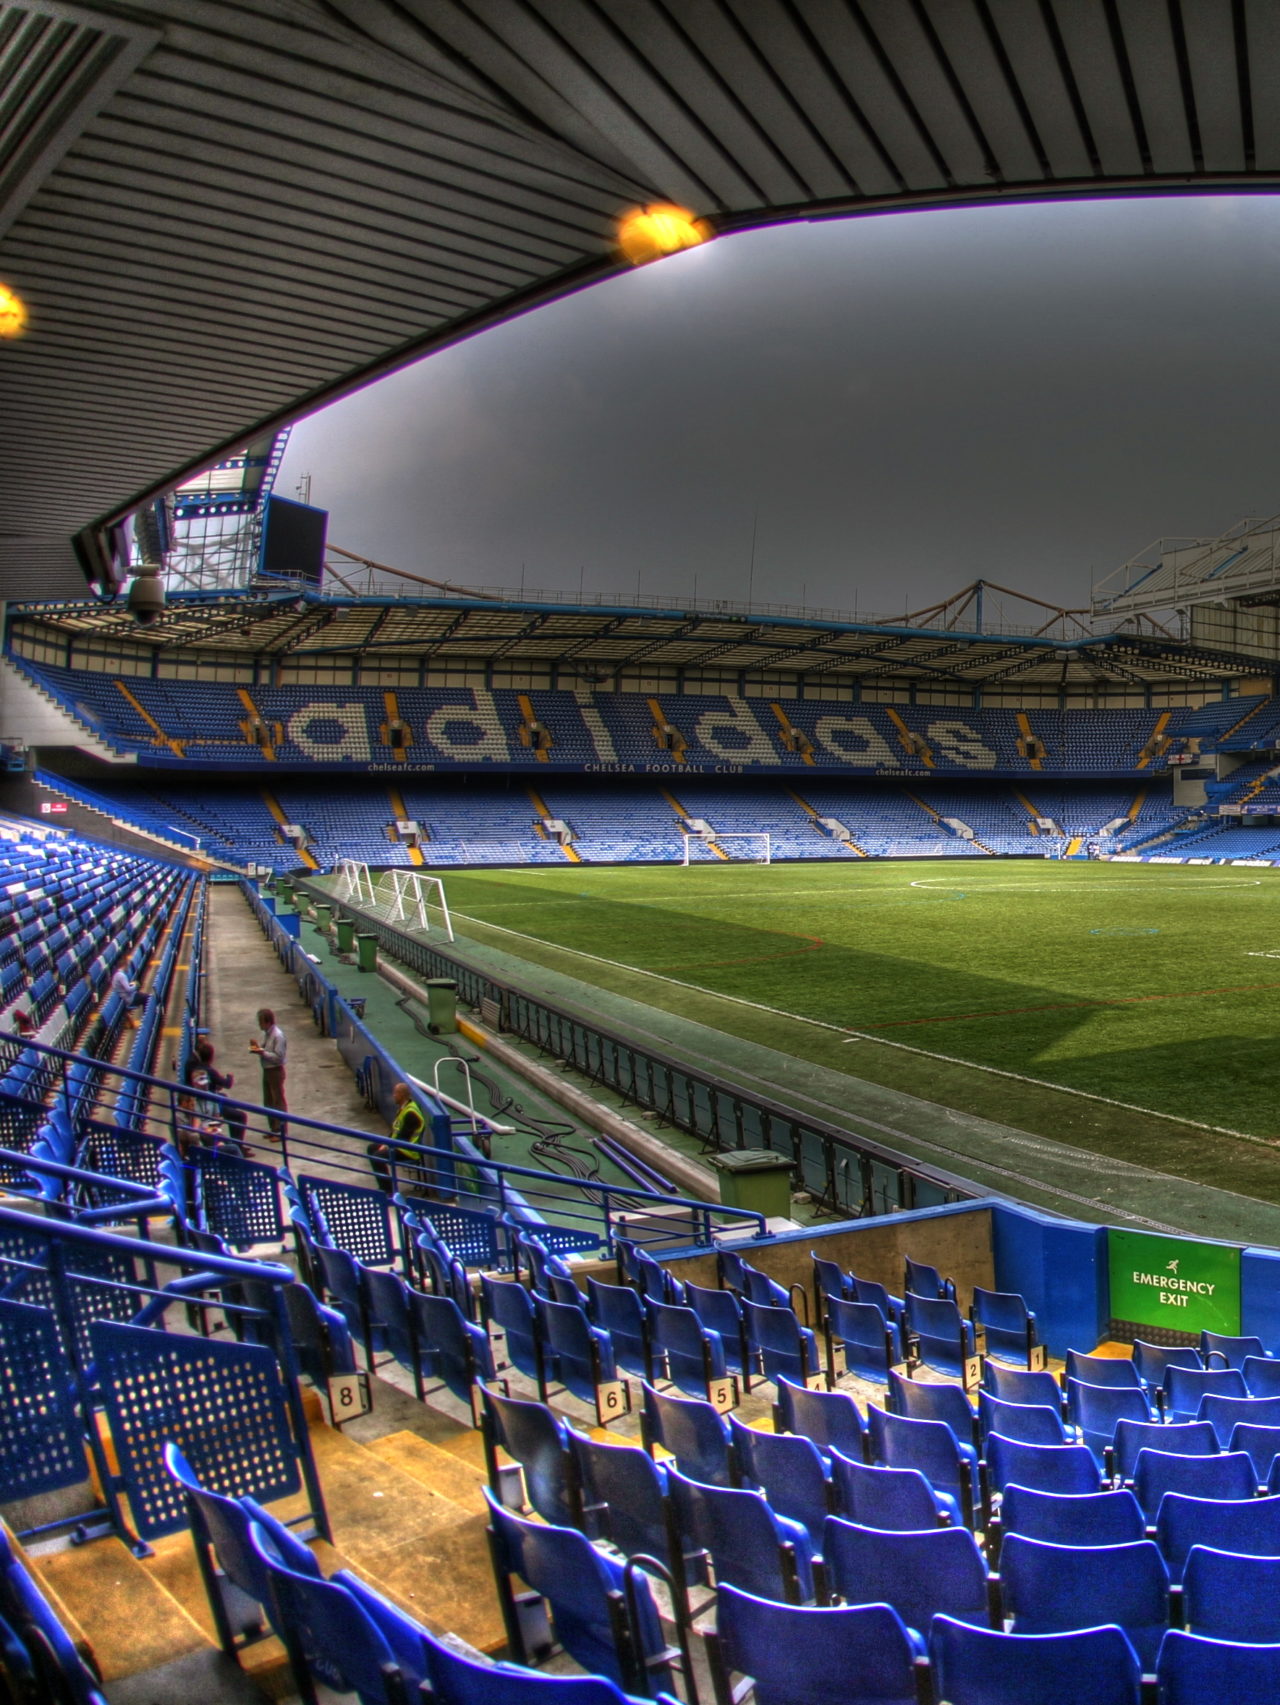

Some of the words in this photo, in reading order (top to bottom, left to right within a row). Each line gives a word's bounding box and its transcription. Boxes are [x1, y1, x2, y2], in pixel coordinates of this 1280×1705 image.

[287, 687, 997, 769] adidas
[368, 763, 435, 772] chelseafc.com
[584, 763, 635, 772] CHELSEA
[646, 764, 705, 773] FOOTBALL
[715, 765, 744, 774] CLUB
[875, 768, 931, 777] chelseafc.com
[1133, 1271, 1215, 1296] EMERGENCY
[1159, 1290, 1189, 1308] EXIT
[969, 1363, 977, 1378] 2
[340, 1386, 353, 1407] 8
[607, 1391, 617, 1408] 6
[716, 1386, 728, 1405] 5
